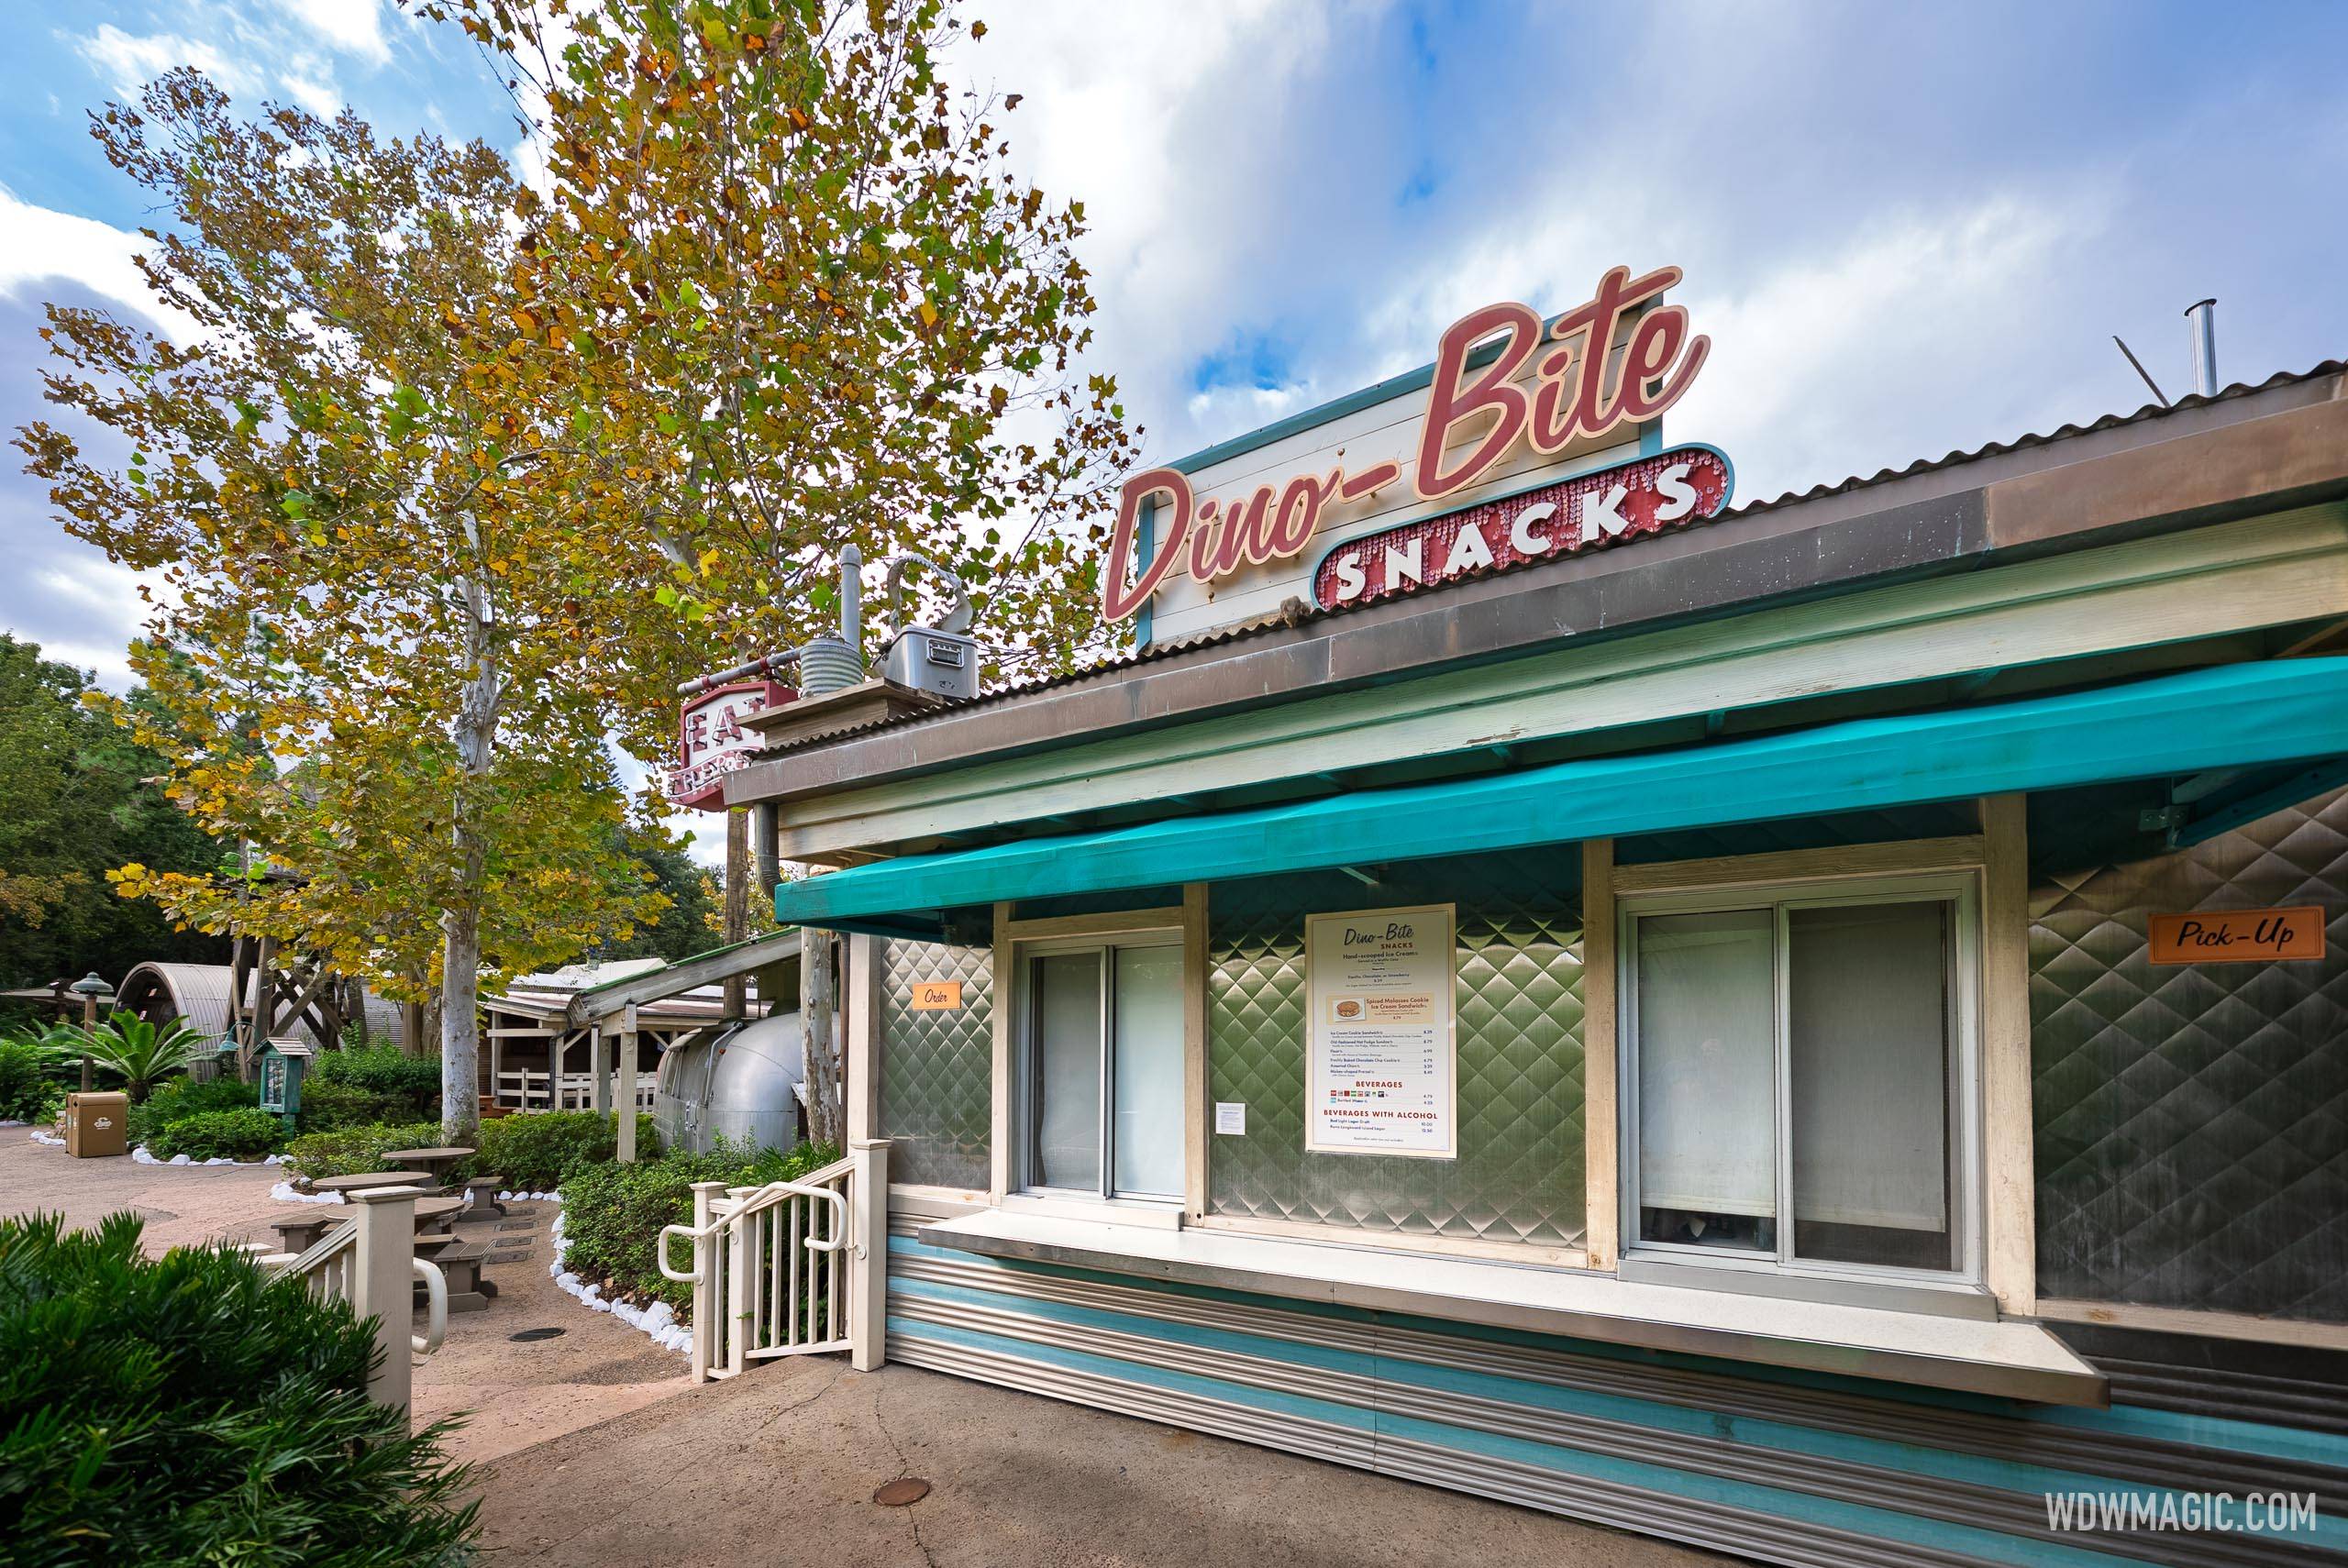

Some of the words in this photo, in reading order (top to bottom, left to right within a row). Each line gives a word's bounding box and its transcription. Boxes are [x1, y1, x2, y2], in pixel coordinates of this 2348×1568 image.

[1102, 266, 1711, 624] Dino-Bite
[1335, 463, 1697, 602] SNACKS
[1344, 922, 1414, 945] Dino-Bite
[2176, 917, 2294, 952] Pick-Up
[1343, 951, 1384, 959] Hand-scooped
[925, 988, 947, 1003] Order
